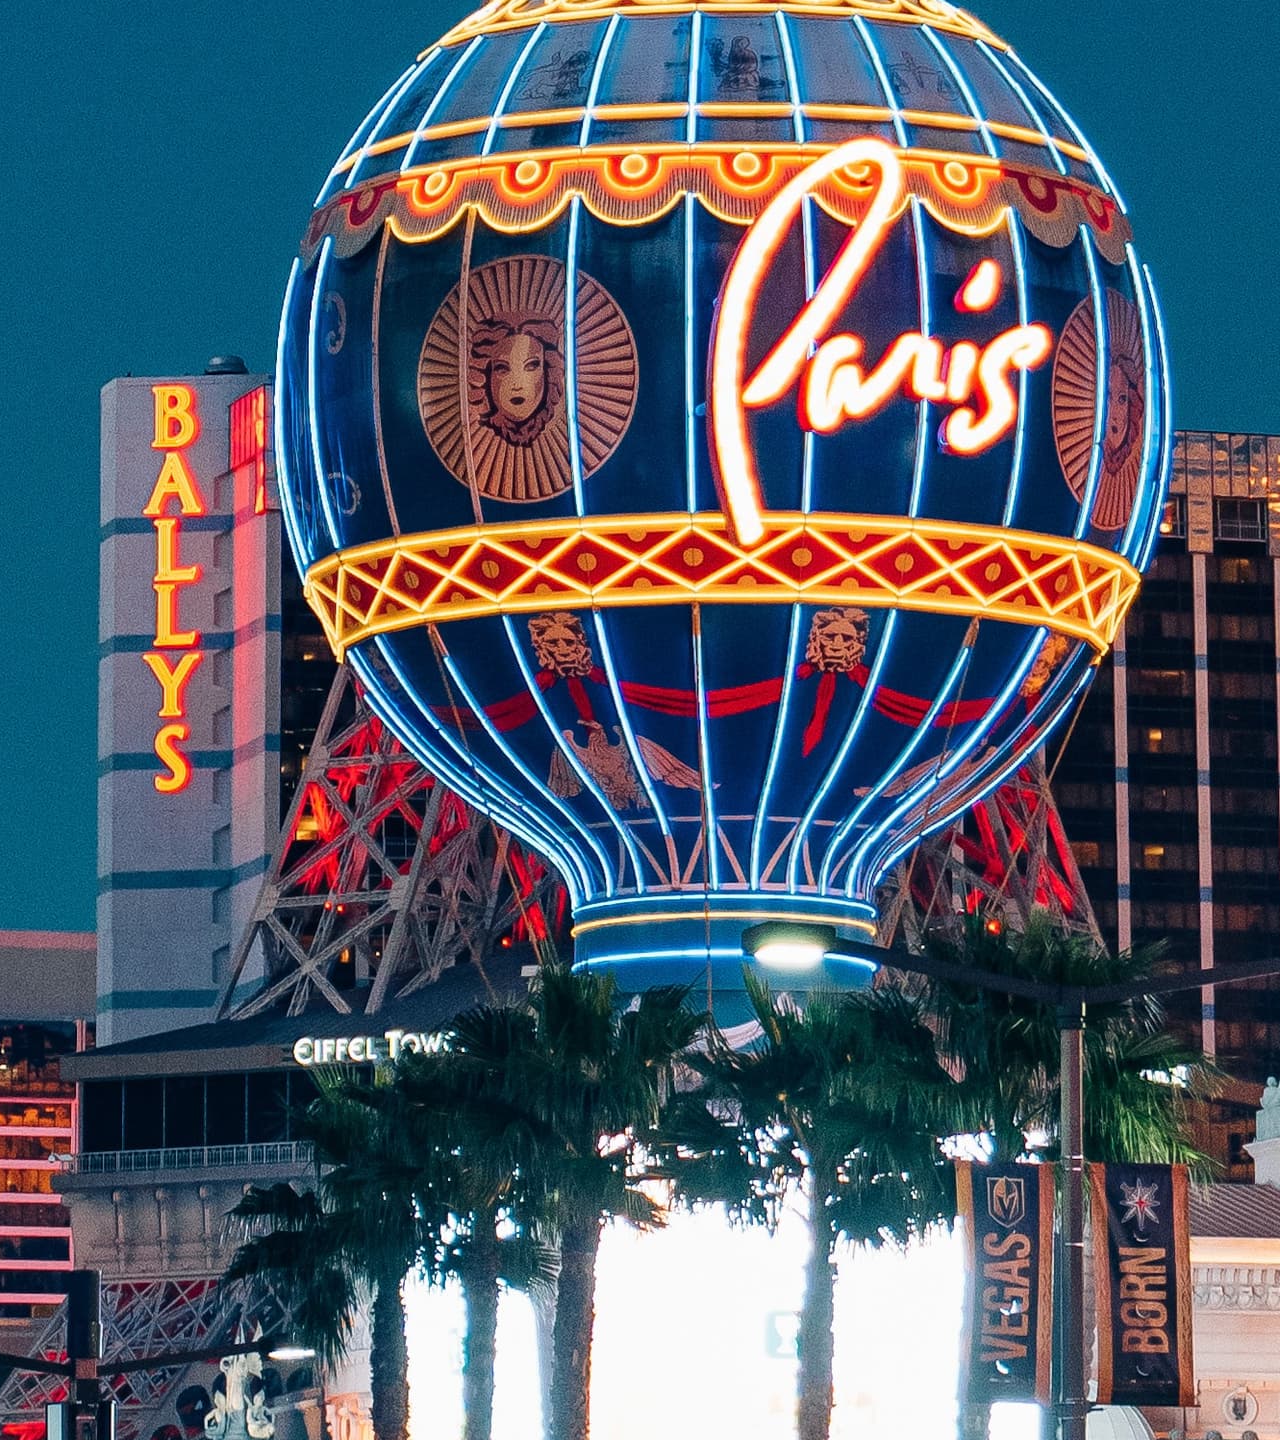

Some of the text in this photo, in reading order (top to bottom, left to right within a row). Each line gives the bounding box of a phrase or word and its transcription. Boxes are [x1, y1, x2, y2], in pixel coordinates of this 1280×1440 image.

[709, 137, 1052, 544] Paris
[143, 385, 200, 793] BALLYS
[293, 1036, 378, 1067] EIFFEL
[980, 1231, 1032, 1362] VEGAS
[1119, 1246, 1170, 1354] BORN
